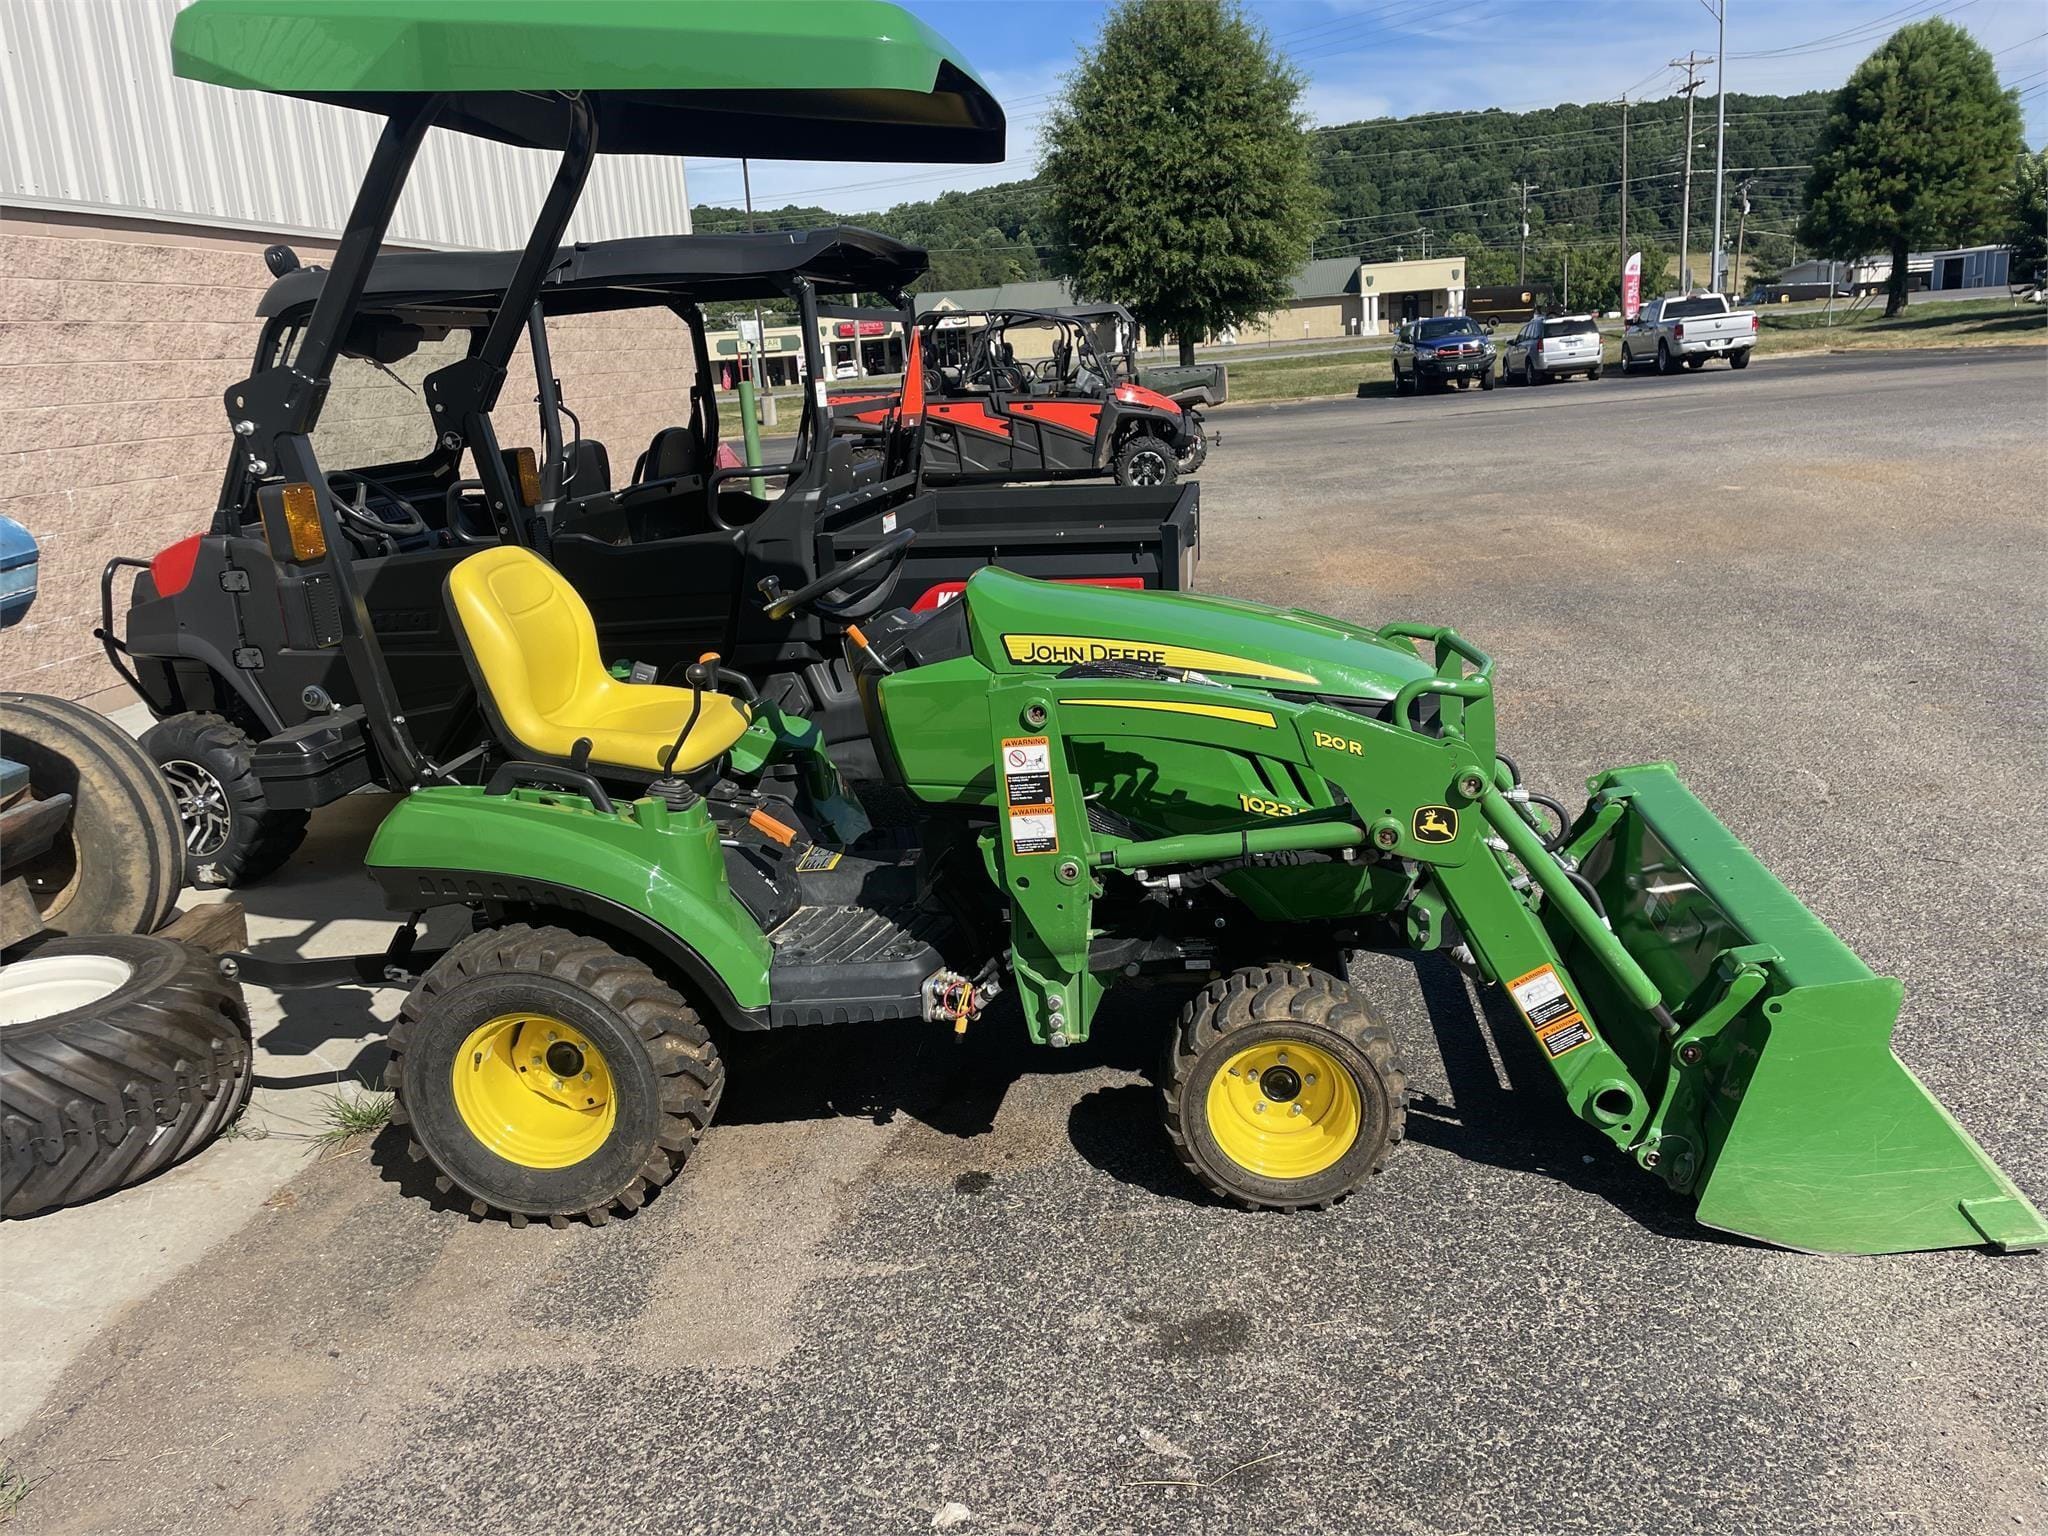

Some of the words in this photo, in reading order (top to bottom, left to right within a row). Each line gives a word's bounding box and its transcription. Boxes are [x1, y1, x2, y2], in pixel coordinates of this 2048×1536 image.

[1023, 642, 1084, 661] JOHN
[1091, 644, 1166, 665] DEERE
[1011, 737, 1046, 747] WARNING
[1017, 806, 1053, 816] WARNING
[1519, 967, 1548, 984] WARNING
